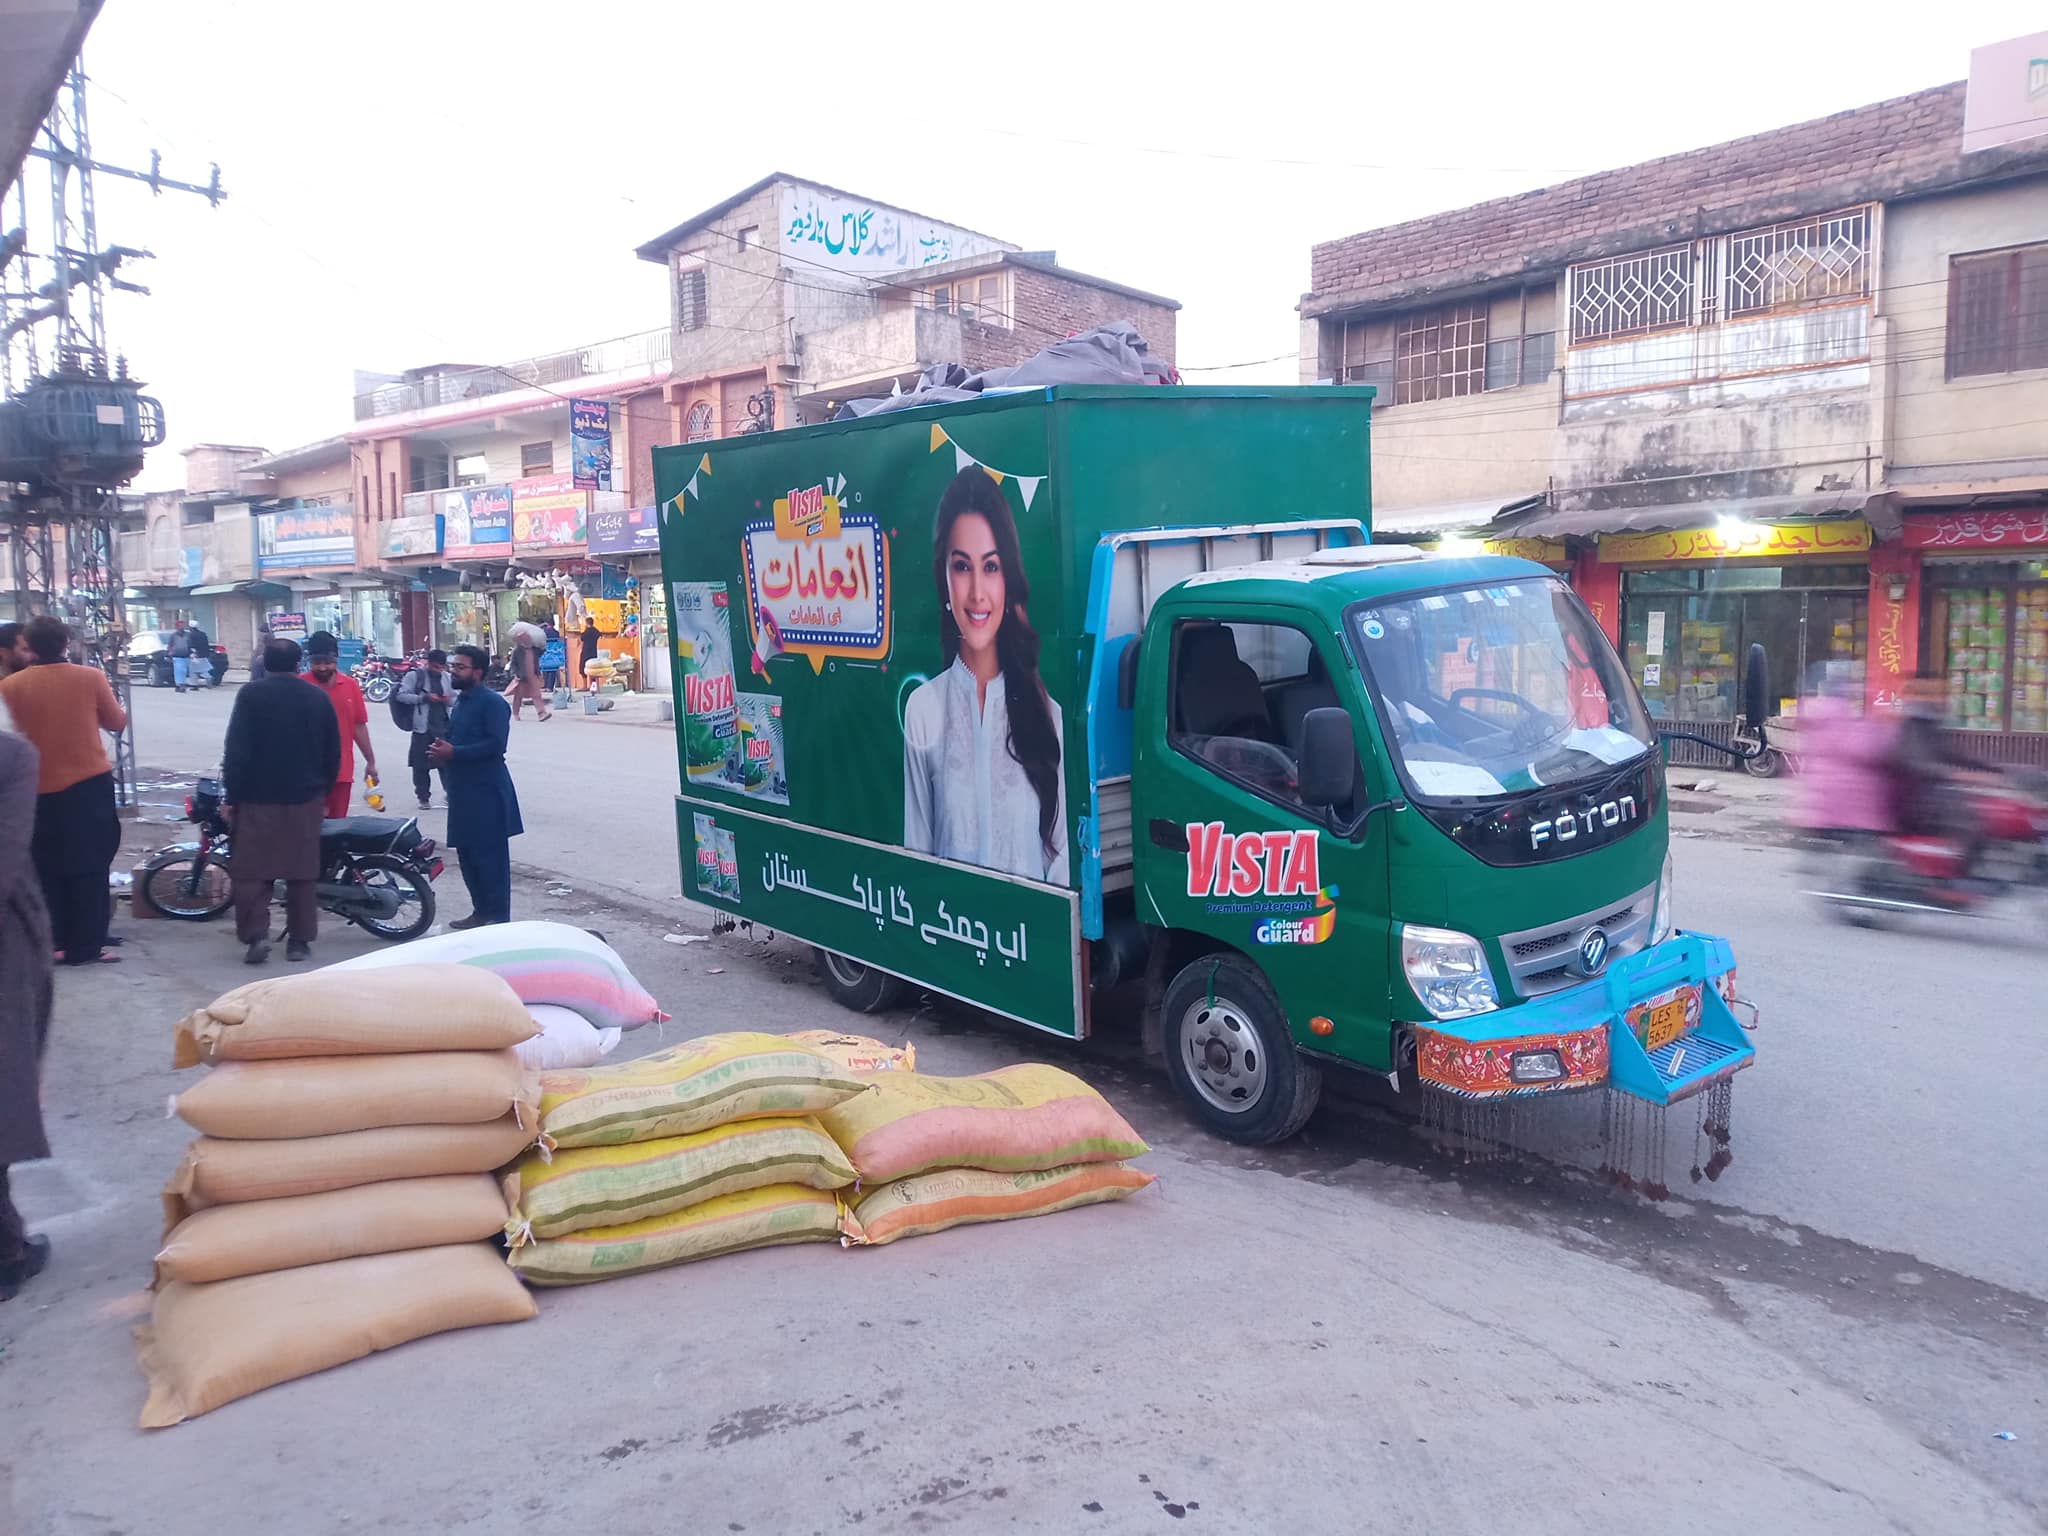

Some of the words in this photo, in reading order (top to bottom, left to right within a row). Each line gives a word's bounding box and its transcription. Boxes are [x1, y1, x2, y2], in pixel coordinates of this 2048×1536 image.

[824, 207, 875, 255] گلاس
[787, 484, 824, 522] VISTA
[1768, 525, 1863, 554] ساجد
[761, 542, 869, 600] انعامات
[685, 671, 735, 715] VISTA
[747, 737, 770, 760] VISTA
[1186, 821, 1321, 897] VISTA
[763, 842, 885, 931] پاکستان
[890, 885, 914, 927] گا
[1207, 902, 1252, 913] Premium
[1254, 900, 1313, 914] Detergent
[1270, 920, 1304, 930] Colour
[921, 900, 989, 966] چمکے
[996, 922, 1027, 968] اب
[1256, 923, 1315, 943] Guard
[1648, 1023, 1673, 1046] 5637
[1651, 1006, 1672, 1027] LES
